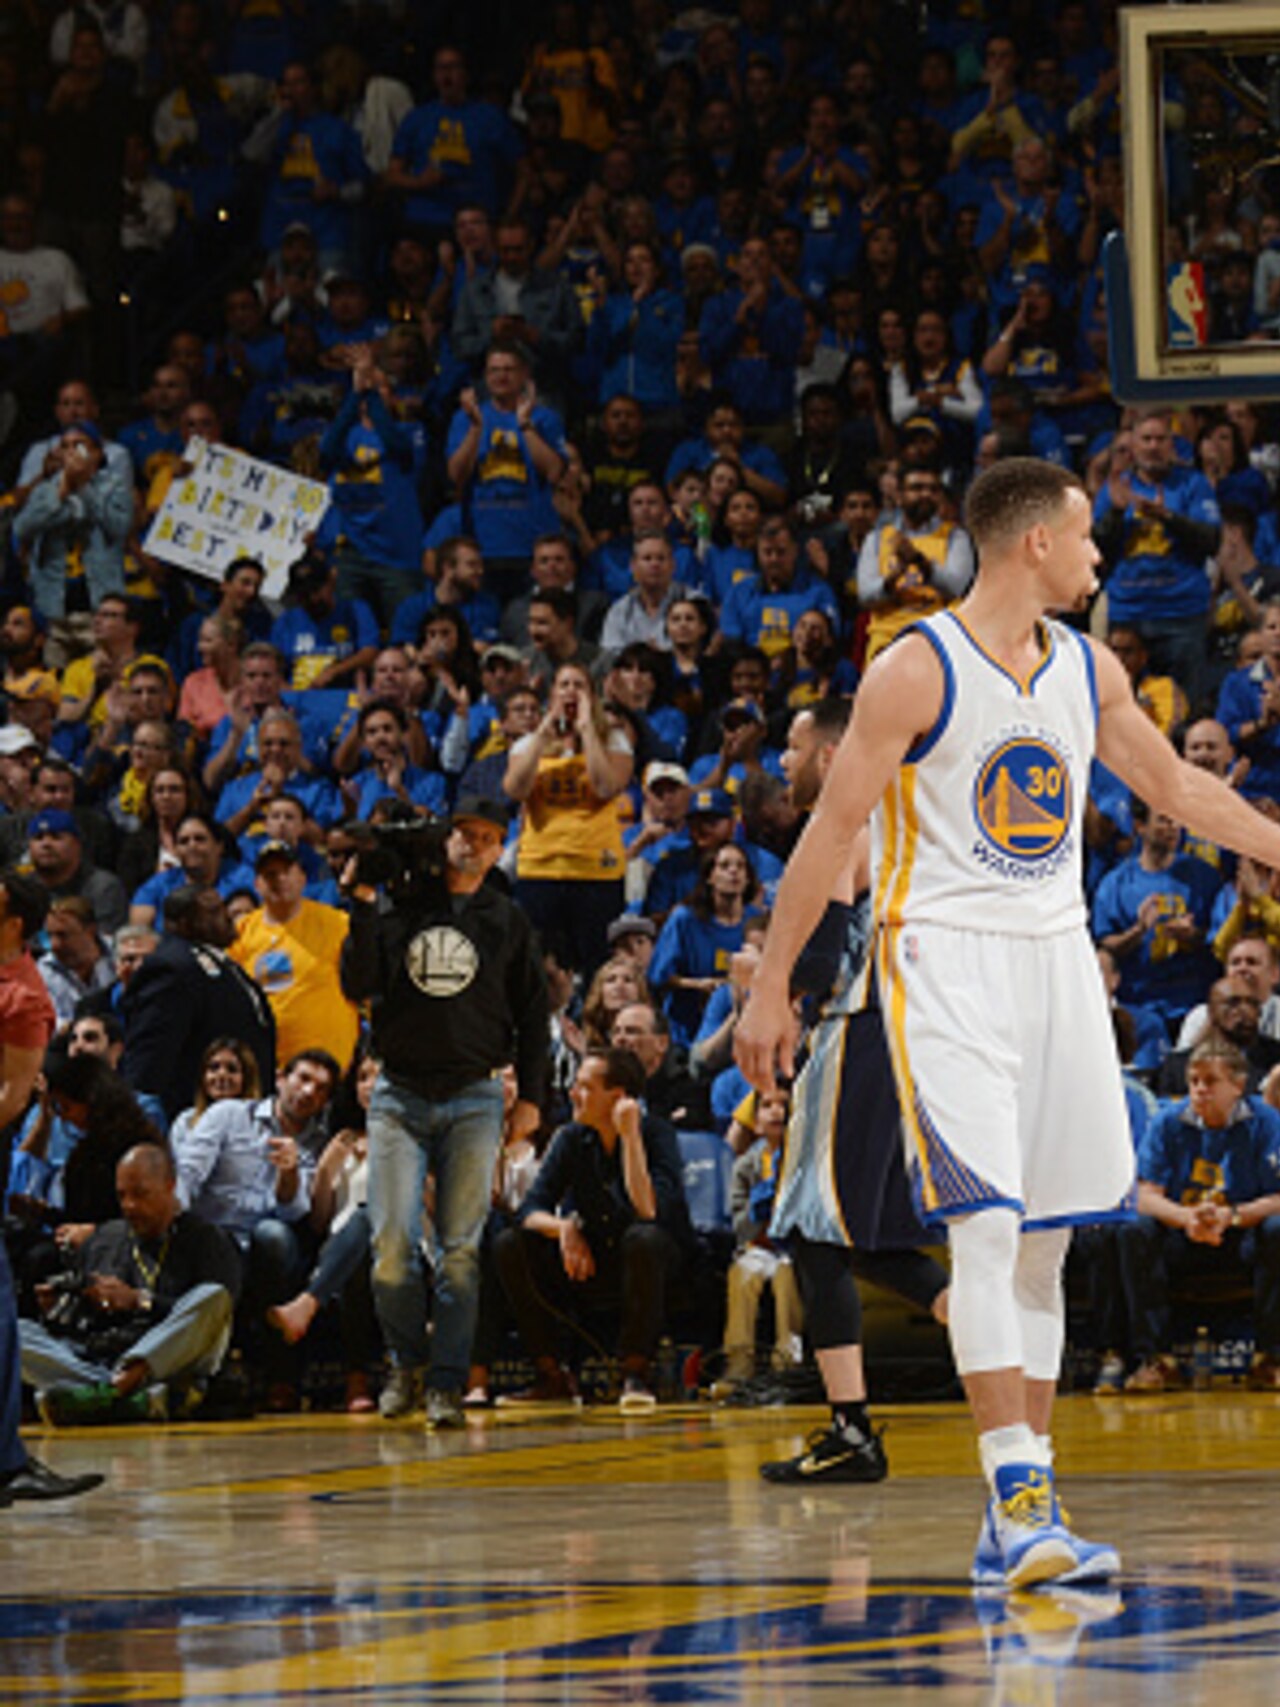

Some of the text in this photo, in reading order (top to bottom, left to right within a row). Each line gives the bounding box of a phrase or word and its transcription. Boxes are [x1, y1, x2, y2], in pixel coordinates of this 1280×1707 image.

[177, 479, 309, 545] BIRTHDAY
[156, 516, 226, 558] BEST
[1026, 765, 1062, 798] 30
